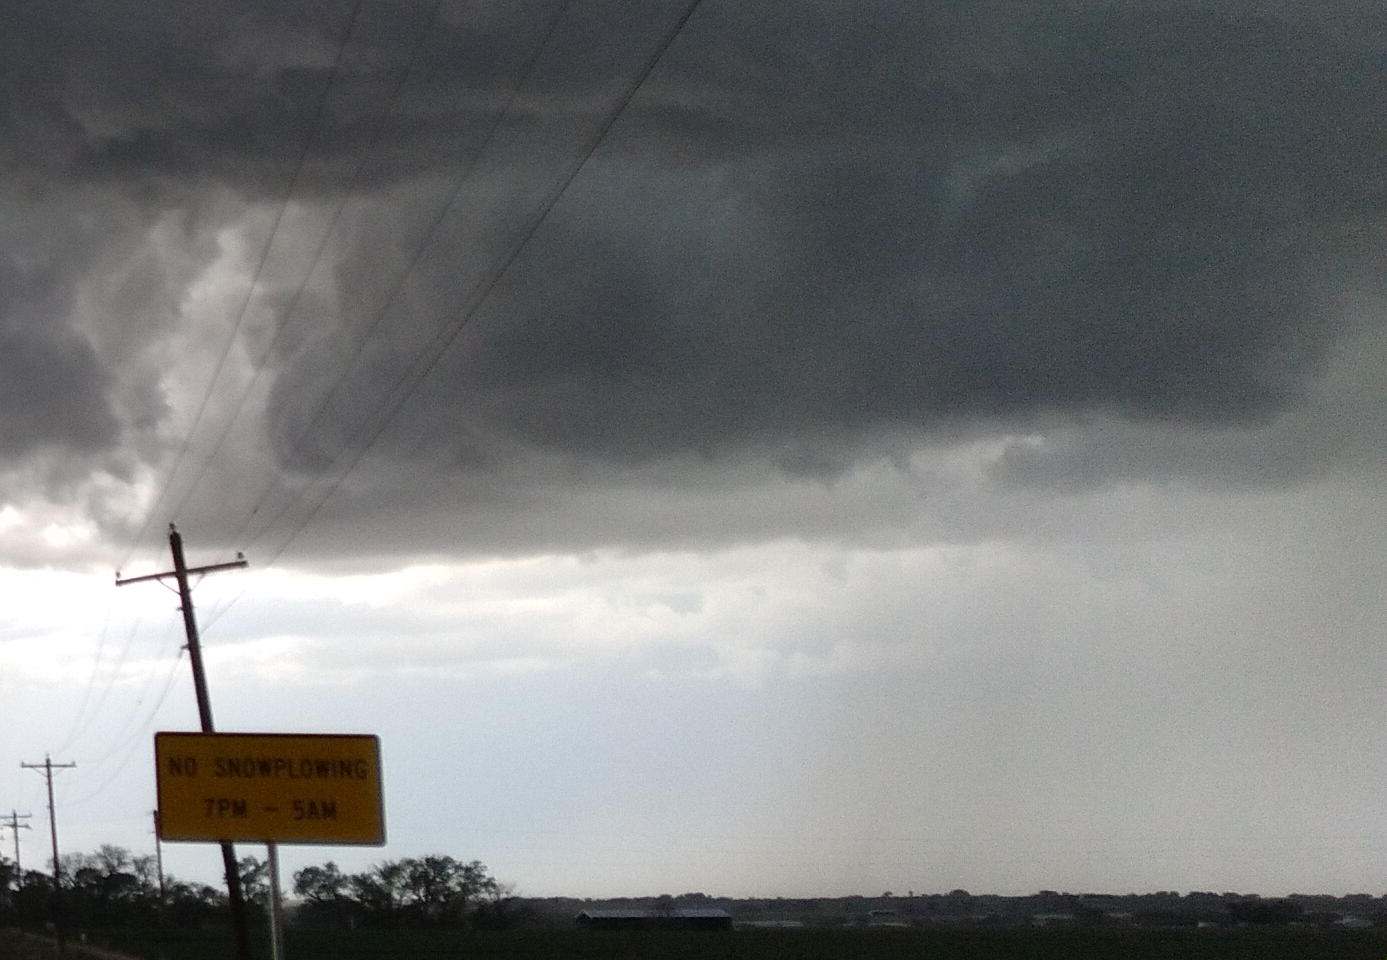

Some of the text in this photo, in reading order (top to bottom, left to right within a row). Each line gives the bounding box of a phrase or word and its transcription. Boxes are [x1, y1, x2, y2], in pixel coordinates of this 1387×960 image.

[168, 757, 368, 780] NO SNOWPLOWING
[204, 798, 247, 819] 7PM
[293, 799, 337, 820] 5AM
